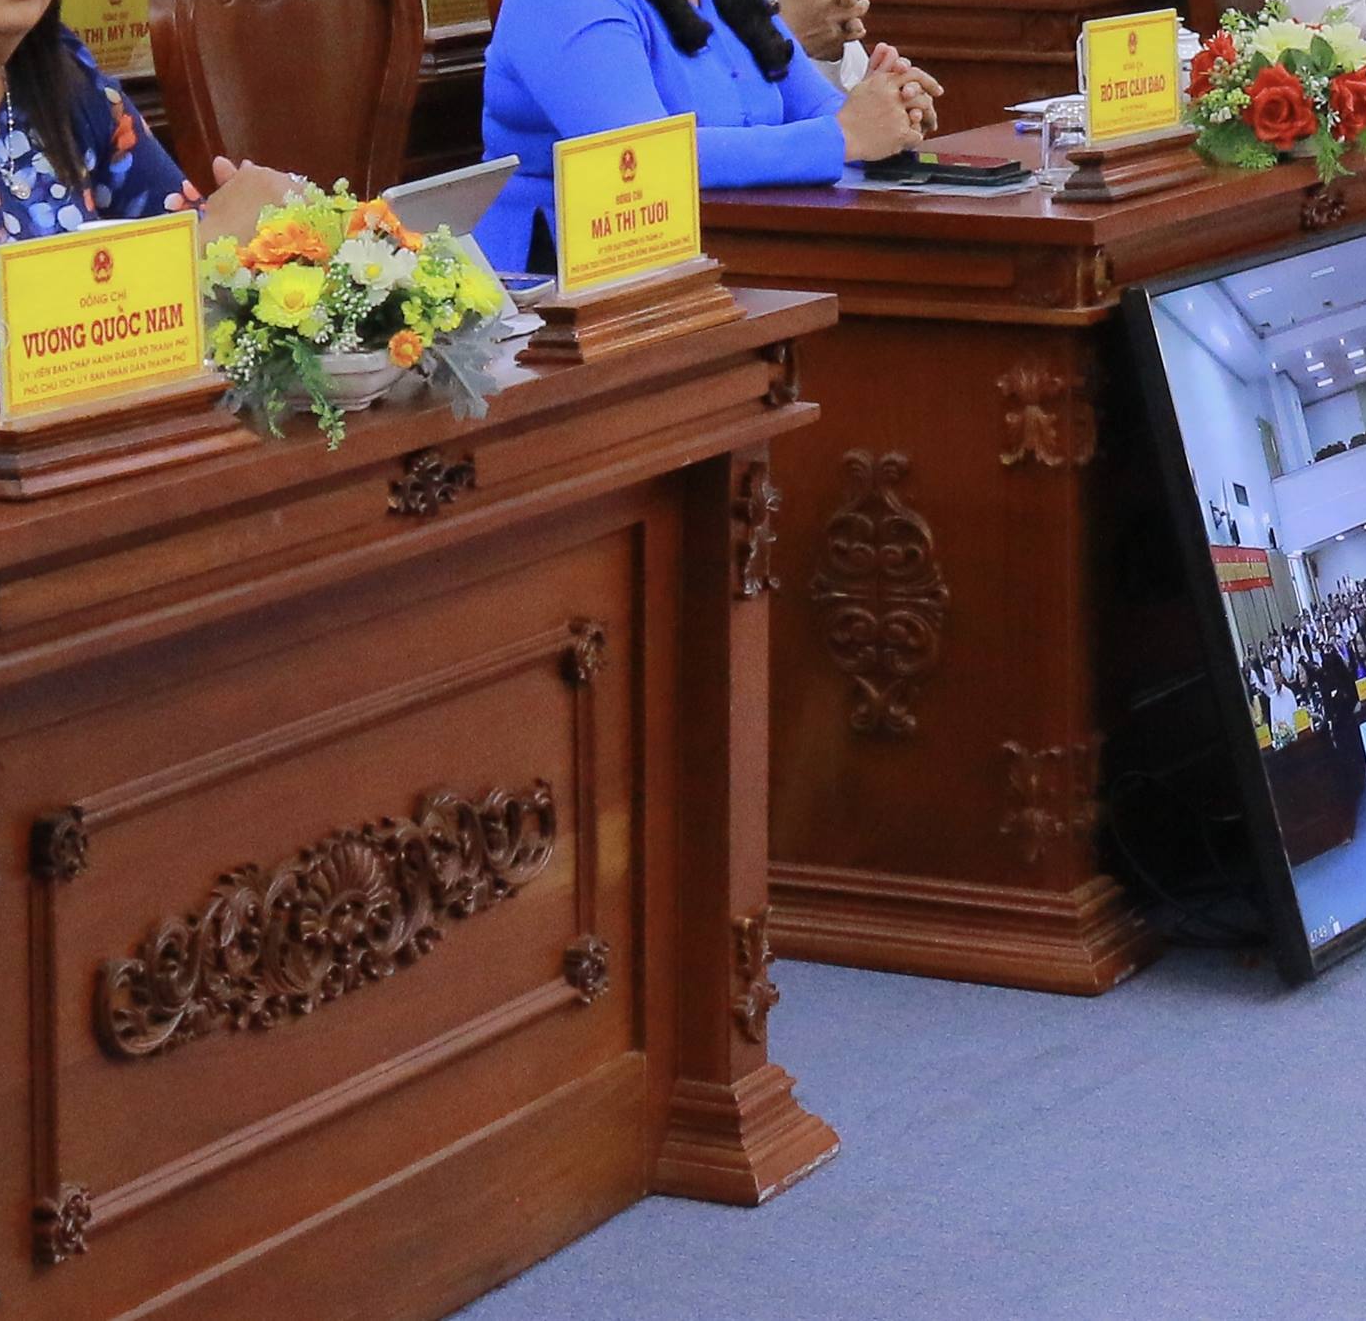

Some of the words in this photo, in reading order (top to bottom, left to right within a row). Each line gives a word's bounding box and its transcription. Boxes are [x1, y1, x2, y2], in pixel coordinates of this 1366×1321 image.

[615, 209, 636, 234] THỊ
[640, 199, 669, 226] TƯƠI
[22, 322, 87, 360] VƯƠNG
[91, 303, 141, 347] QUỐC
[145, 303, 184, 334] NAM
[53, 363, 68, 375] BAN
